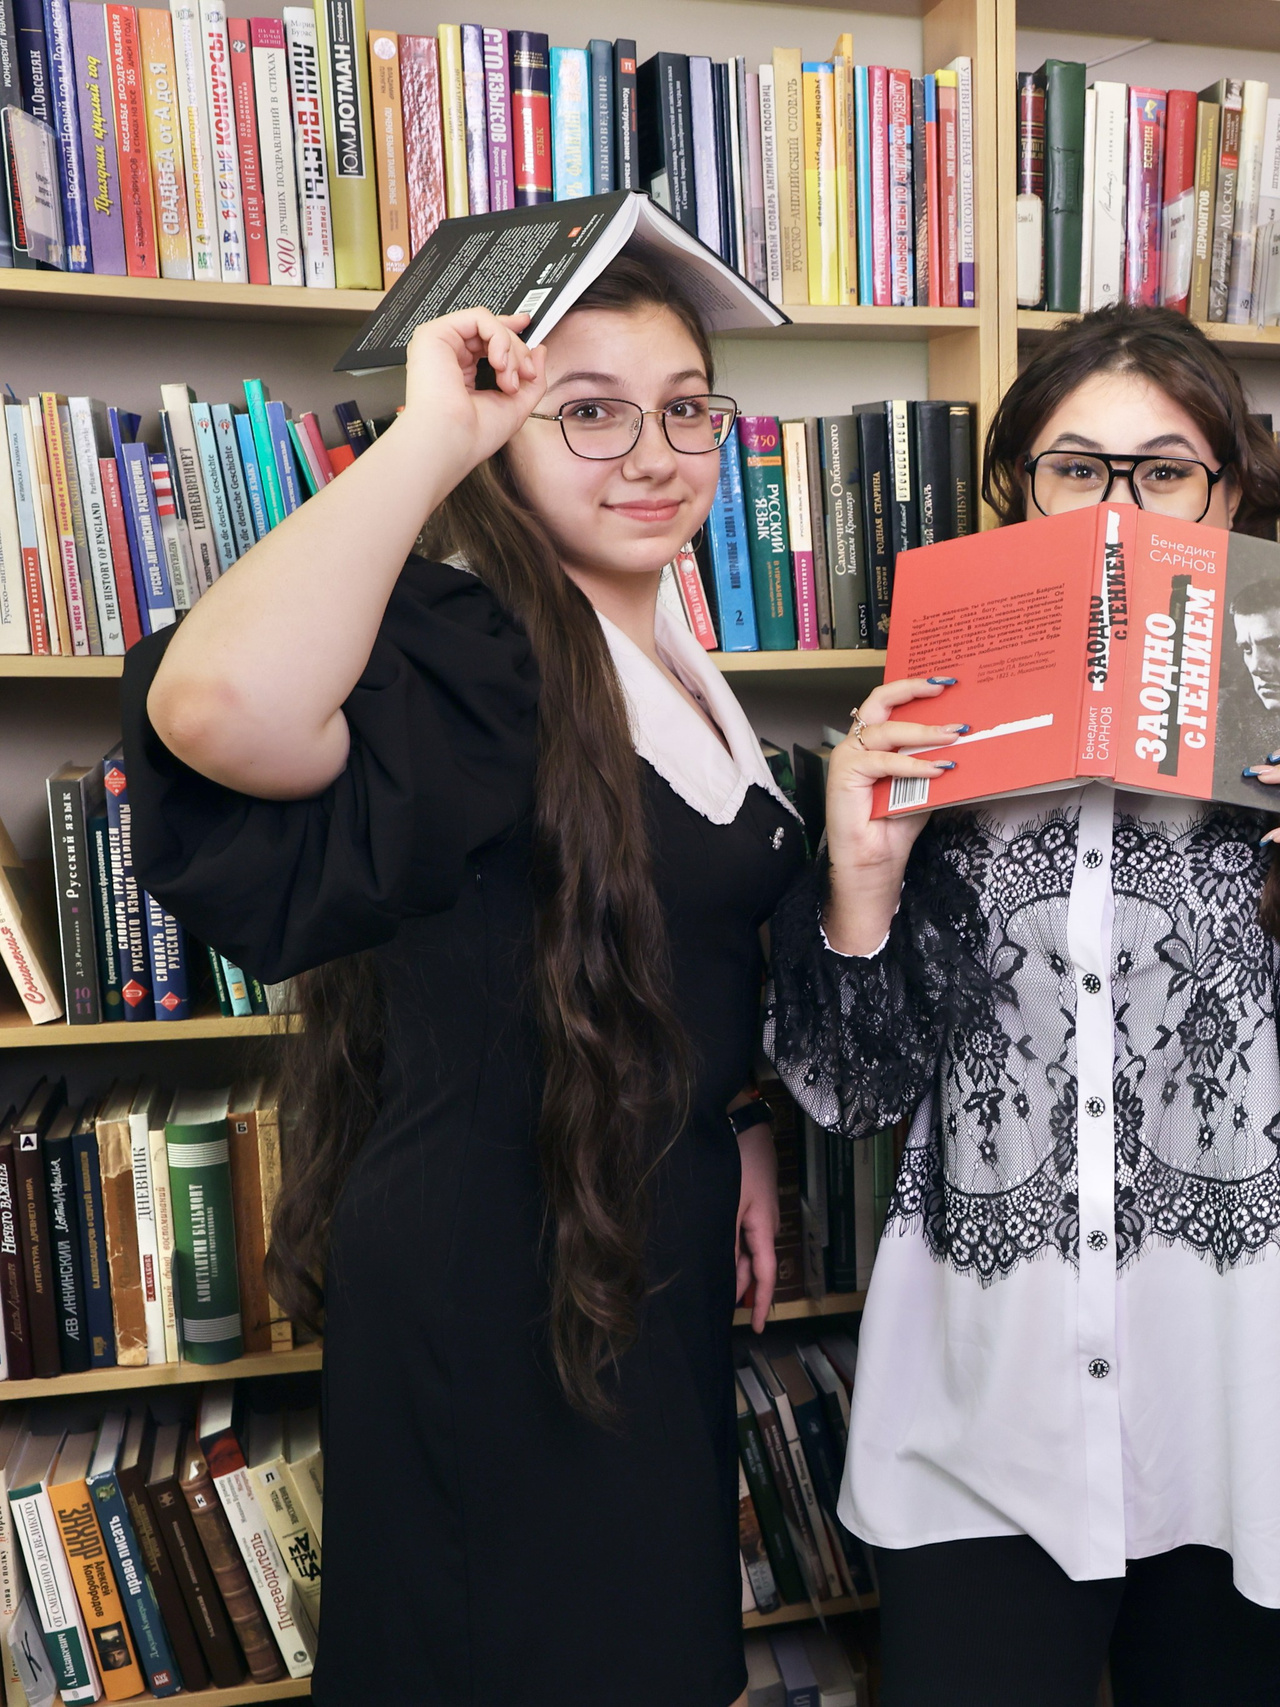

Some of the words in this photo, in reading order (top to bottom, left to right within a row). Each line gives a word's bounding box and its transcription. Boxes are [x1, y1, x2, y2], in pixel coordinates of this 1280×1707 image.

[87, 55, 100, 78] год
[149, 62, 167, 76] Я
[269, 53, 277, 92] СТИХАХ
[483, 28, 504, 69] СТО
[127, 70, 135, 86] 365
[208, 33, 231, 145] КОНКУРСЫ
[892, 80, 905, 114] ЯЗЫКУ
[58, 102, 72, 144] Новый
[87, 83, 107, 139] круглый
[292, 42, 325, 200] ЛИНГВИСТЫ
[485, 72, 506, 142] ЯЗЫКОВ
[599, 74, 609, 181] ЯЗЫКОВЕДЕНИЕ
[622, 88, 631, 161] Конструирование
[762, 83, 772, 131] ПОСЛОВИЦ
[788, 78, 798, 132] СЛОВАРЬ
[961, 66, 971, 166] УДИВИТЕЛЬНАЯ
[271, 107, 285, 187] ПОЗДРАВЛЕНИЙ
[765, 134, 776, 190] АНГЛИЙСКИХ
[893, 115, 904, 183] АНГЛИЙСКОМУ
[1143, 125, 1154, 169] ЕСЕНИН
[93, 143, 113, 216] Праздник
[156, 149, 180, 235] СВАДЬБА
[217, 150, 238, 219] ВЕСЕЛЫЕ
[1221, 172, 1233, 229] МОСКВА
[278, 192, 288, 235] ЛУЧШИХ
[769, 192, 777, 234] СЛОВАРЬ
[897, 201, 907, 233] ТЕМЫ
[963, 169, 973, 258] ЭТИМОЛОГИЯ
[1196, 189, 1209, 259] ЛЕРМОНТОВ
[276, 238, 296, 278] 800
[769, 234, 781, 282] ТОЛКОВЫЙ
[898, 234, 908, 297] АКТУАЛЬНЫЕ
[13, 433, 21, 468] ГРАММАТИКА
[753, 435, 775, 447] 750
[831, 424, 844, 497] Олбанского
[130, 459, 148, 513] РАЗГОВОРНИК
[180, 447, 206, 530] LEHRERBEIHEFT
[207, 454, 220, 493] Geschichte
[225, 445, 238, 489] Geschichte
[214, 495, 226, 529] deutsche
[232, 491, 245, 530] deutsche
[845, 491, 857, 536] Кронгауз
[874, 471, 883, 514] СТАРИНА
[93, 502, 106, 545] ENGLAND
[755, 498, 769, 540] ЯЗЫК
[767, 483, 785, 553] РУССКИЙ
[835, 498, 845, 576] Самоучитель
[876, 518, 884, 555] РОДНАЯ
[98, 547, 108, 559] OF
[847, 537, 857, 575] Максим
[1149, 549, 1216, 574] САРНОВ
[1150, 533, 1217, 559] Бенедикт
[28, 556, 38, 604] РЕПЕТИТОР
[98, 561, 114, 603] HISTORY
[801, 558, 809, 600] РЕПЕТИТОР
[1106, 542, 1128, 626] ГЕНИЕМ
[104, 605, 116, 621] THE
[735, 610, 744, 625] 2
[1087, 596, 1108, 685] ЗАОДНО
[1179, 583, 1214, 730] ГЕНИЕМ
[1135, 613, 1177, 762] ЗАОДНО
[1081, 705, 1098, 760] Бенедикт
[1095, 705, 1113, 760] САРНОВ
[63, 792, 74, 830] язык
[120, 804, 132, 867] ПАРОНИМЫ
[63, 836, 81, 898] Русский
[109, 828, 124, 895] ТРУДНОСТЕЙ
[126, 876, 141, 914] ЯЗЫКА
[115, 901, 128, 950] СЛОВАРЬ
[130, 919, 143, 972] РУССКОГО
[74, 987, 91, 999] 10
[75, 1002, 92, 1014] 11
[22, 1136, 34, 1148] А
[237, 1123, 247, 1133] Б
[133, 1147, 154, 1221] ДНЕВНИК
[30, 1201, 39, 1241] ДРЕВНЕГО
[189, 1184, 206, 1237] БАЛЬМОНТ
[33, 1244, 43, 1294] ЛИТЕРАТУРА
[59, 1240, 78, 1315] АННИНСКИЙ
[193, 1240, 211, 1302] КОНСТАНТИН
[66, 1318, 80, 1340] ЛЕВ
[58, 1502, 103, 1560] ЗАХАР
[109, 1515, 130, 1558] писать
[83, 1564, 103, 1617] Колобродов
[95, 1560, 112, 1596] Алексей
[122, 1559, 142, 1595] право
[58, 1633, 75, 1677] Казакевич
